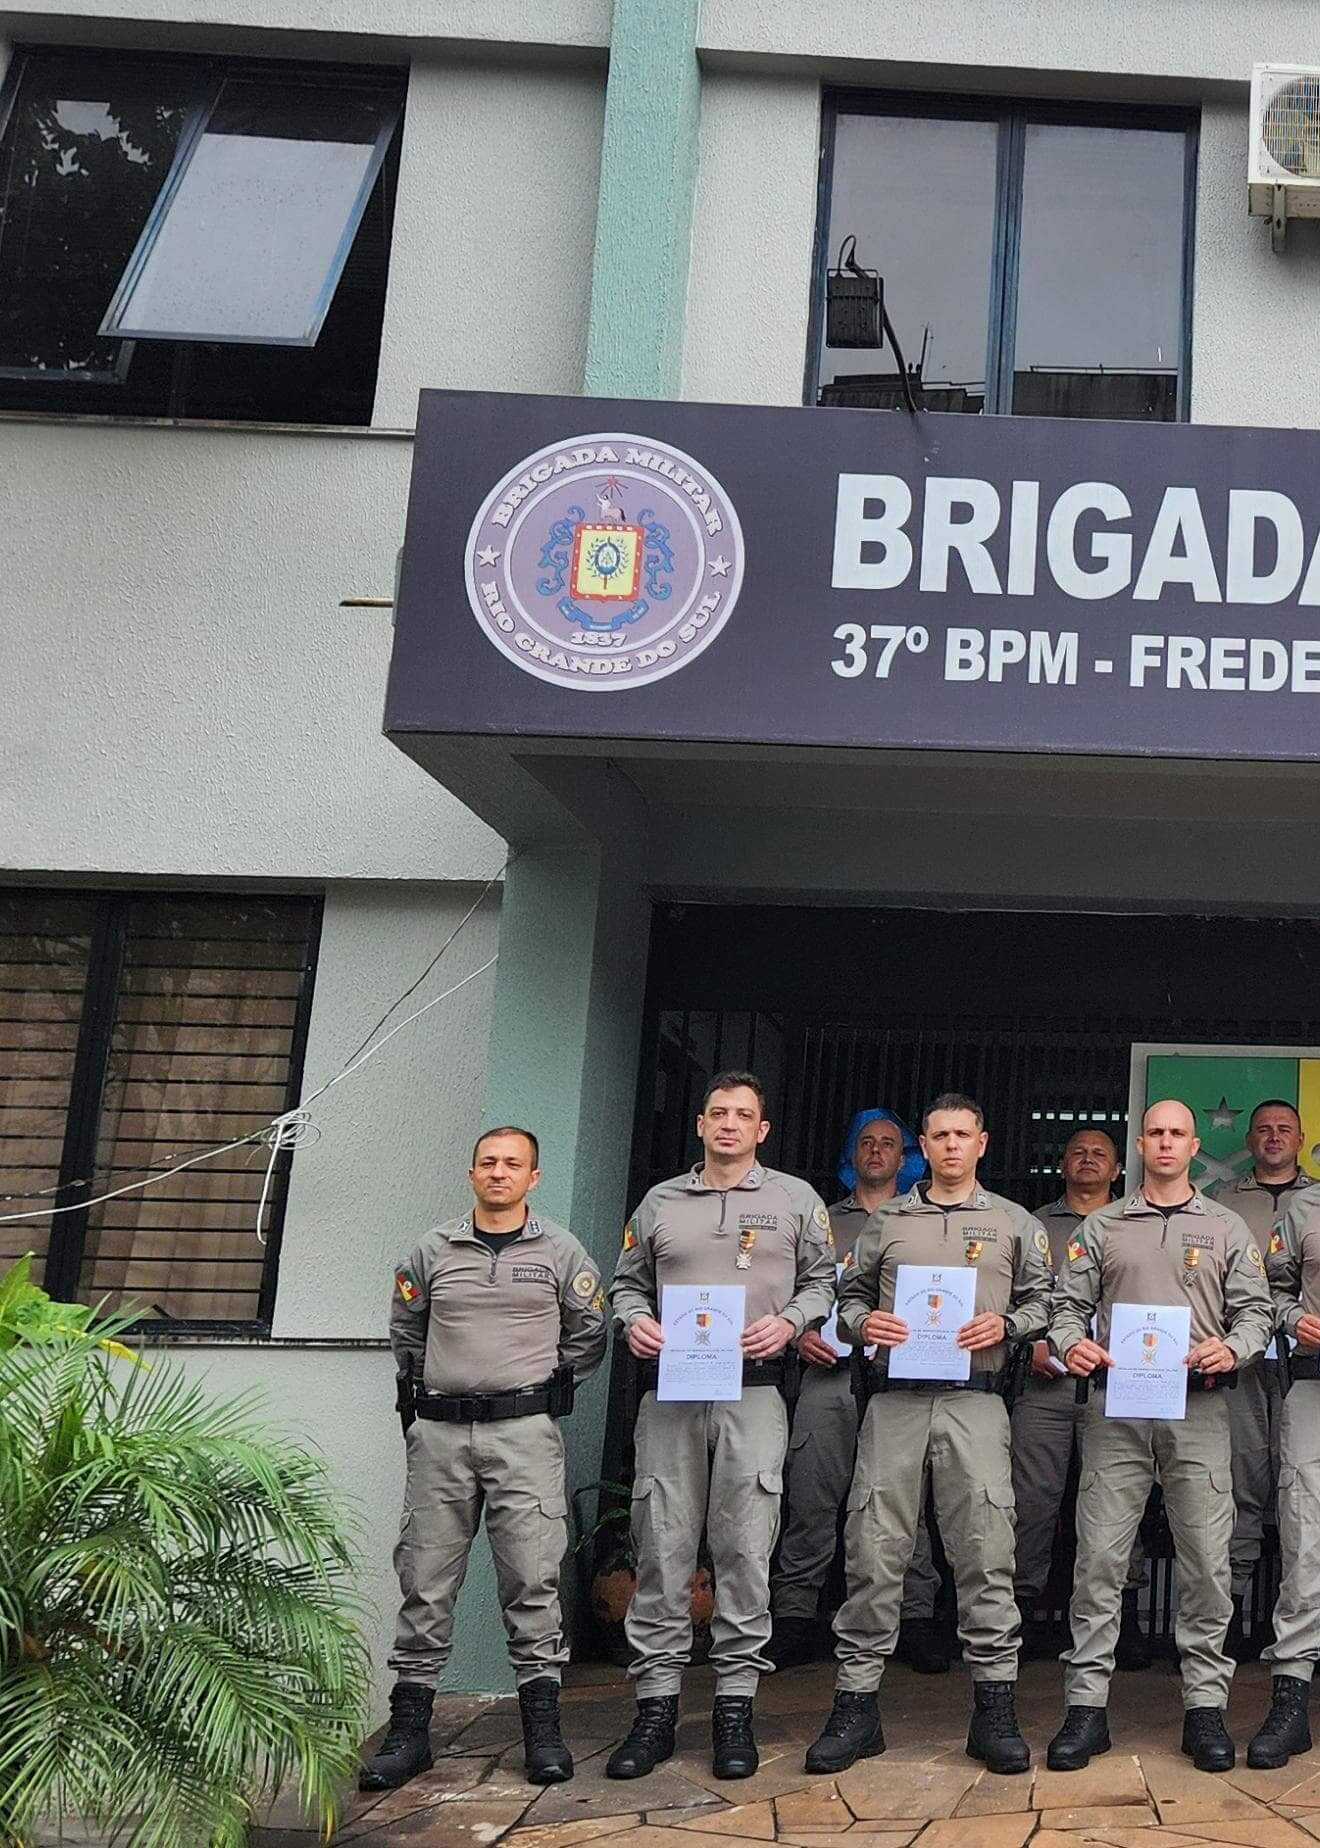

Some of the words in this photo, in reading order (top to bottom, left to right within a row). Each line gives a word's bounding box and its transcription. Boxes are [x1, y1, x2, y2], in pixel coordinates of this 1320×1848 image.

[492, 446, 618, 528] BRIGADA
[625, 447, 724, 537] MILITAR
[481, 581, 516, 634] RIO
[515, 632, 633, 674] GRANDE
[638, 640, 677, 668] DO
[679, 591, 722, 643] SUL
[944, 627, 1079, 685] BPM
